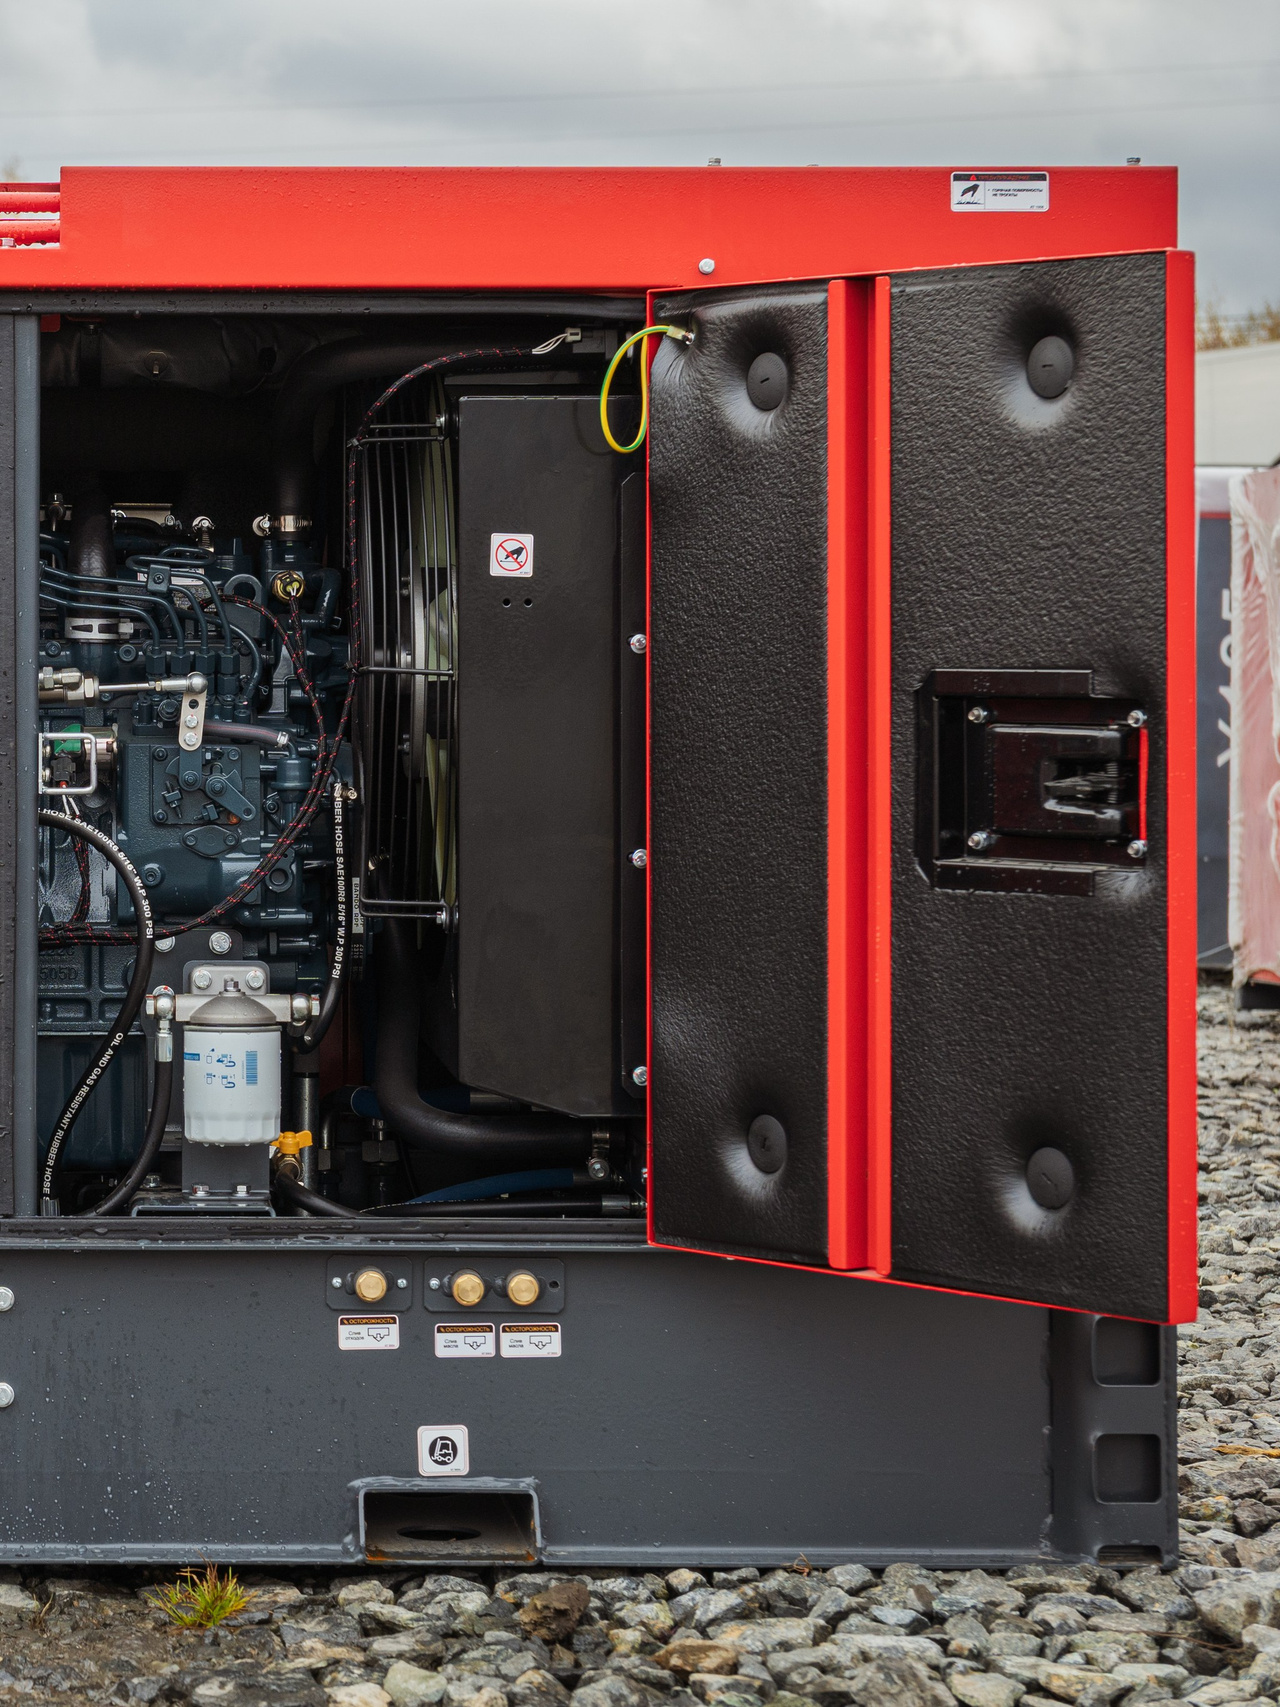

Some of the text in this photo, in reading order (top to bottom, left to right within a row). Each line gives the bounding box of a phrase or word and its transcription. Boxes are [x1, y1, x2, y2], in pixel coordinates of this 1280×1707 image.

[43, 808, 72, 820] HOSE
[335, 825, 343, 854] HOSE
[336, 856, 345, 902] SAE100R6
[142, 899, 152, 918] 300
[145, 920, 154, 939] PSI
[335, 946, 344, 962] 300
[332, 963, 342, 979] PSI
[110, 1032, 124, 1047] OIL
[98, 1048, 114, 1068] AND
[86, 1067, 102, 1086] GAS
[59, 1084, 90, 1130] RESISTANT
[46, 1129, 65, 1167] RUBBER
[43, 1167, 53, 1195] HOSE
